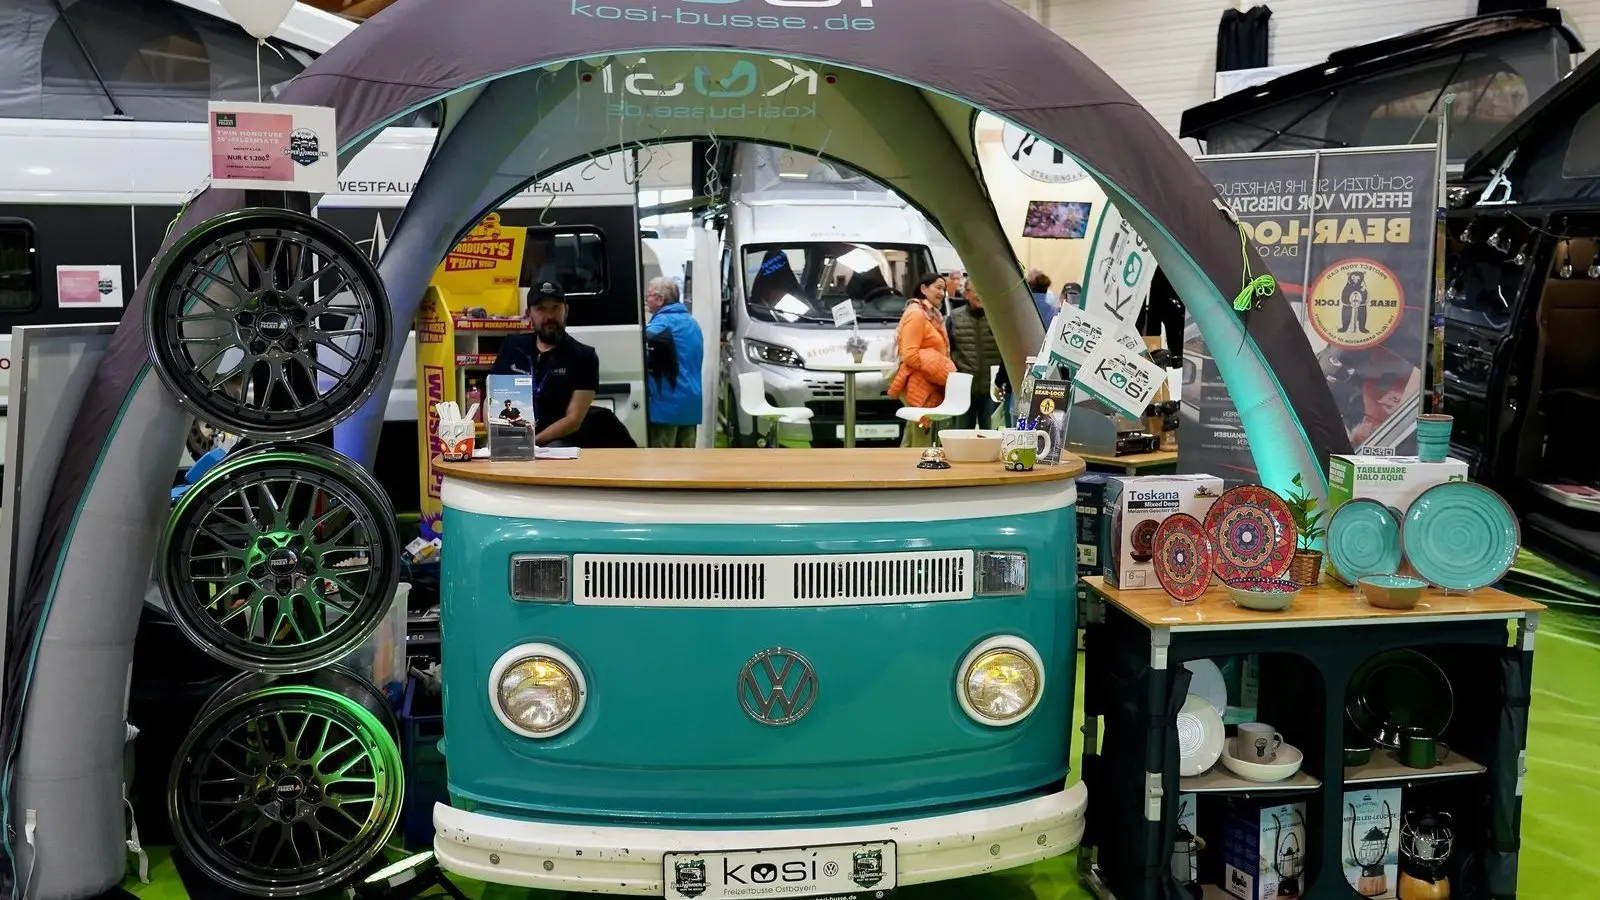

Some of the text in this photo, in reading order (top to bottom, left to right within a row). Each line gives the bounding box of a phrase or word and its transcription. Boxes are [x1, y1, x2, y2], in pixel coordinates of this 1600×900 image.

[570, 3, 876, 31] kosi-busse.de
[449, 257, 477, 269] THAT
[1356, 466, 1407, 474] TABLEWARE
[1129, 490, 1180, 501] Toskana
[1144, 500, 1179, 508] Mixed Deep
[1128, 572, 1135, 580] 6
[723, 852, 818, 886] kosi
[723, 885, 817, 896] Freizeitbusse Ostbayern
